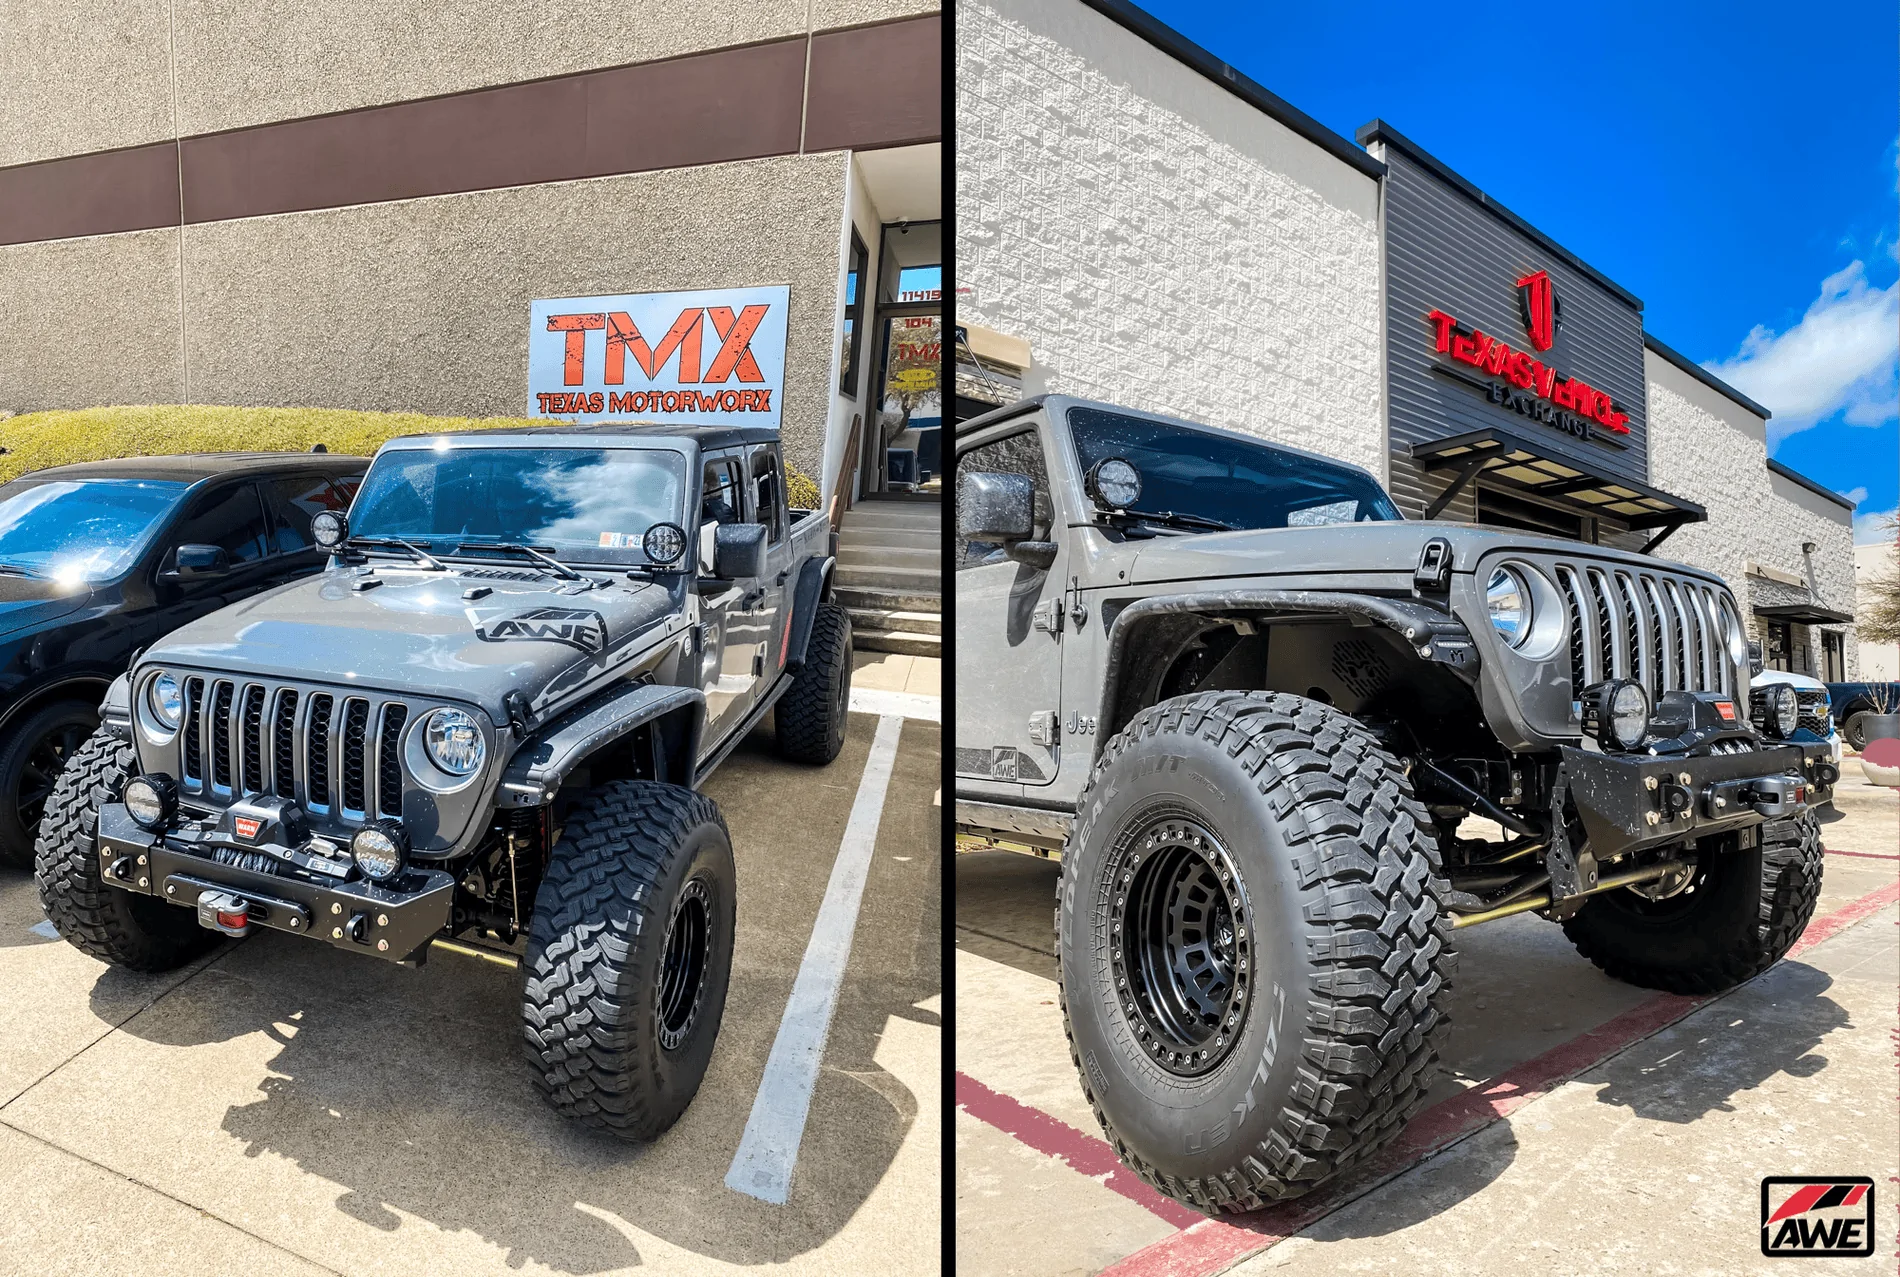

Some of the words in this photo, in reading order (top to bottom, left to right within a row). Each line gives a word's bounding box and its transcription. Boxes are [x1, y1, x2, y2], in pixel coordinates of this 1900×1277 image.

[902, 290, 941, 301] 11419
[905, 318, 932, 328] 104
[547, 304, 770, 386] TMX
[898, 343, 941, 361] TMX
[1428, 309, 1533, 389] TEXAS
[538, 391, 604, 414] TEXAS
[608, 389, 771, 413] MOTORWORX
[1488, 382, 1595, 440] EXCHANGE
[489, 620, 599, 646] AWE
[1066, 710, 1097, 735] Jee
[994, 764, 1015, 778] AWE
